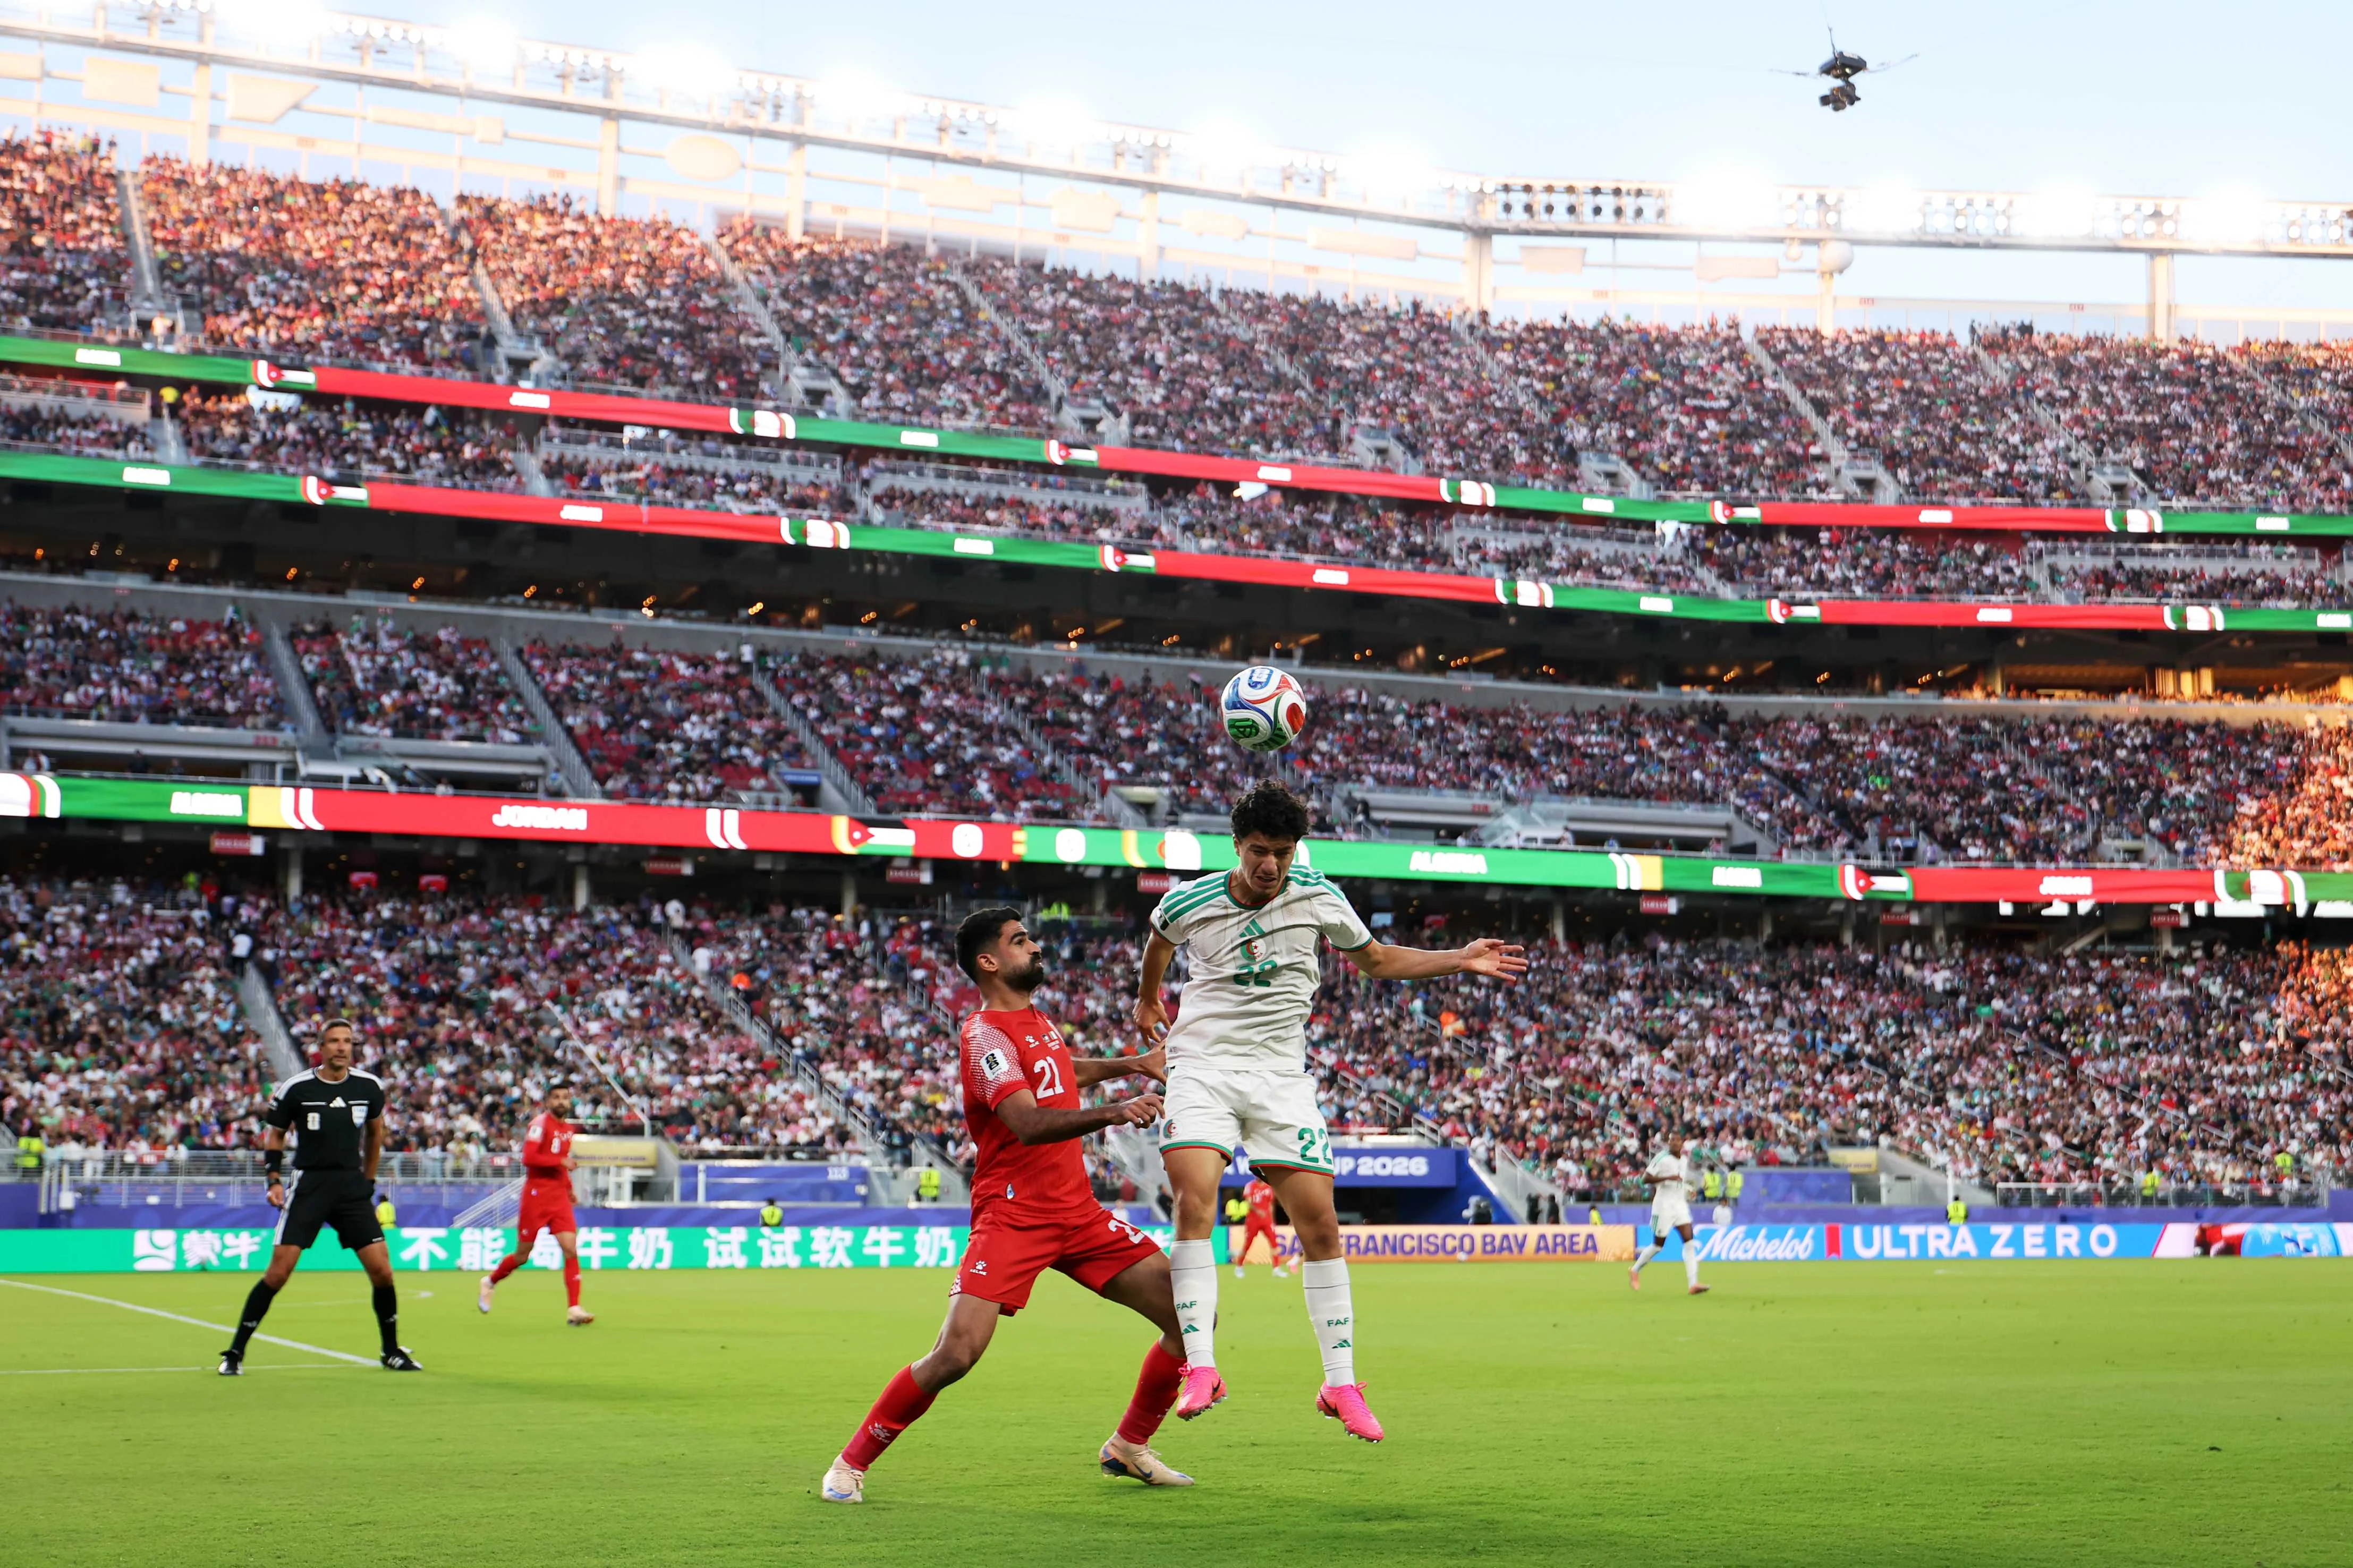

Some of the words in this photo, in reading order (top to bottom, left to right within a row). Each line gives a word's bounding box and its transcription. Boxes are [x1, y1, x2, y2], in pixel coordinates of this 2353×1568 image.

[492, 805, 588, 830] JORDAN
[1033, 1056, 1064, 1099] 21
[1298, 1127, 1332, 1165] 22
[1357, 1156, 1429, 1177] 2026
[182, 1230, 261, 1270] 蒙牛
[703, 1226, 956, 1268] 试试软牛奶
[1482, 1233, 1527, 1256] BAY
[1534, 1233, 1598, 1256] AREA
[1693, 1223, 1815, 1262] Michelob
[1854, 1225, 1977, 1258] ULTRA
[1990, 1224, 2118, 1258] ZERO
[1176, 1300, 1197, 1312] FAF
[1327, 1317, 1350, 1327] FAF
